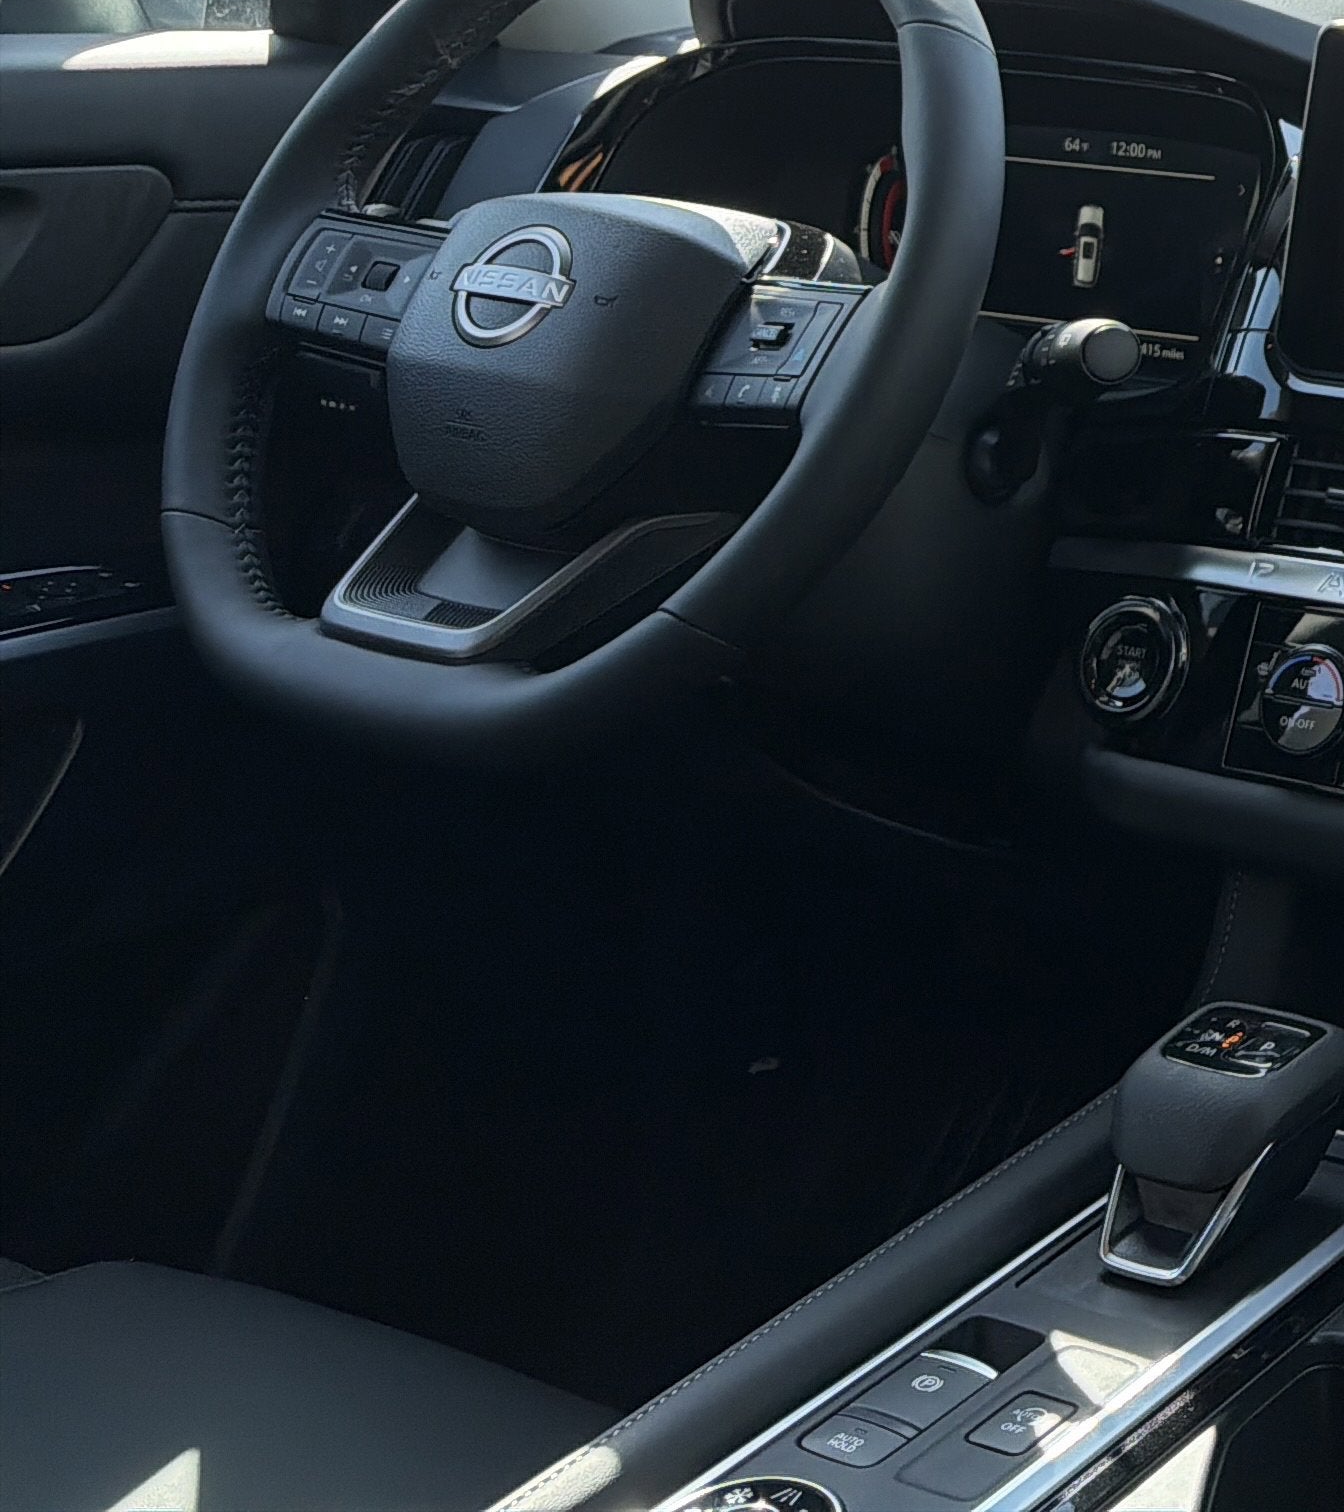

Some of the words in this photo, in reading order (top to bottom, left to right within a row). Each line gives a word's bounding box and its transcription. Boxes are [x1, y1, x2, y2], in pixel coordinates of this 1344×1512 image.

[1111, 141, 1146, 158] 12:00
[1147, 149, 1162, 160] PM
[463, 269, 569, 302] NISSAN
[1117, 646, 1147, 659] START
[1000, 1422, 1027, 1435] OFF
[826, 1438, 857, 1454] HOLD
[836, 1432, 865, 1447] AUTO
